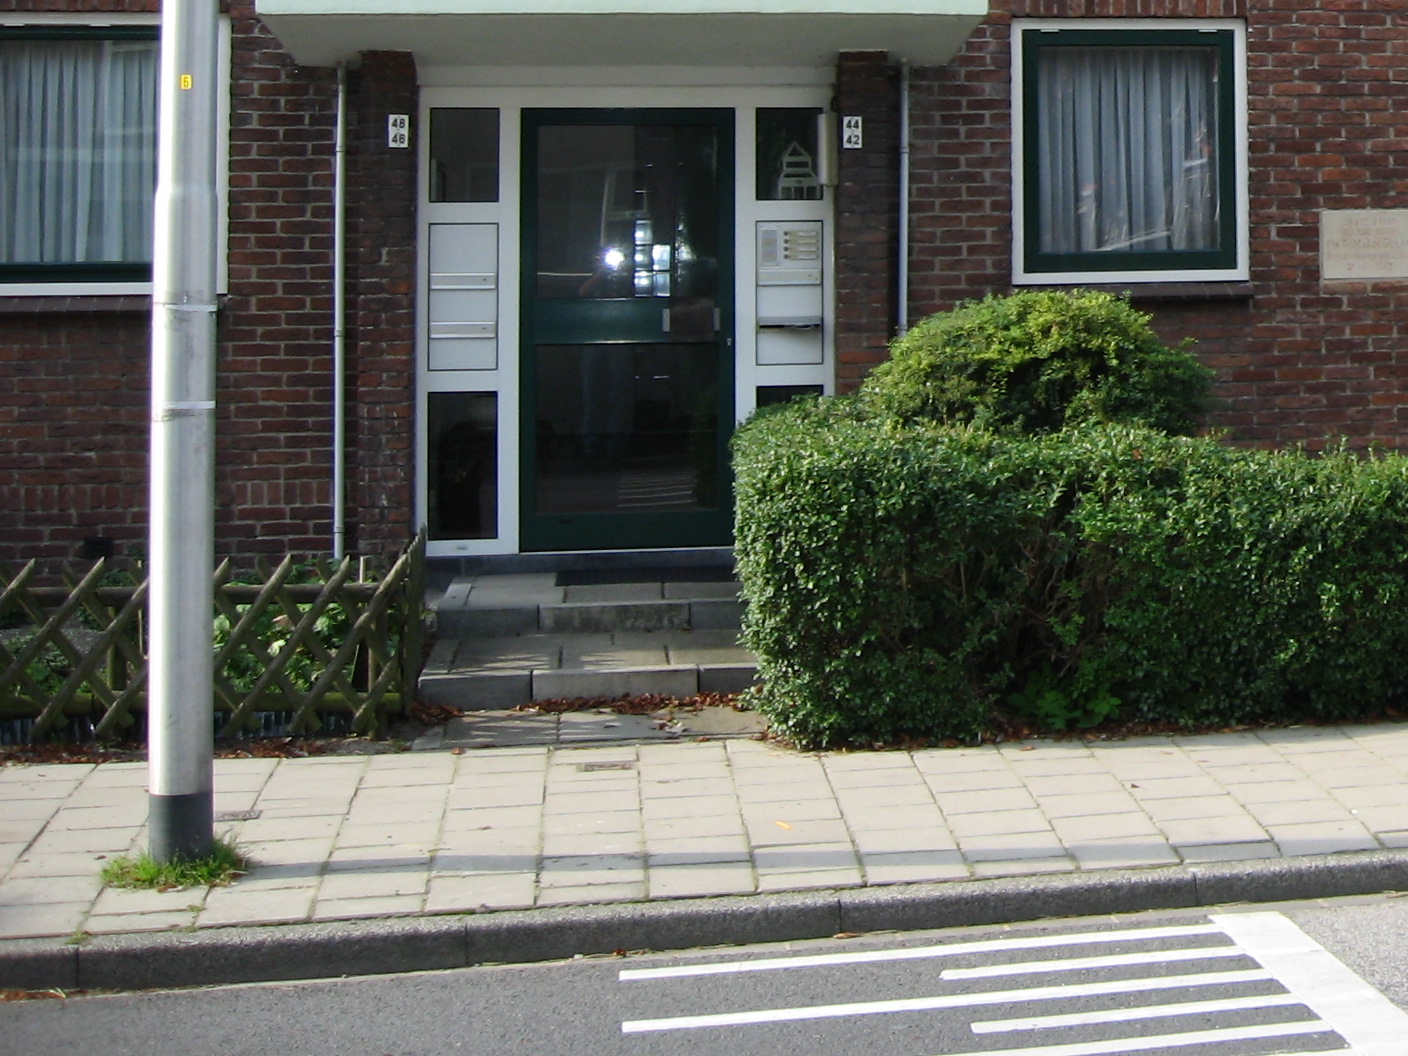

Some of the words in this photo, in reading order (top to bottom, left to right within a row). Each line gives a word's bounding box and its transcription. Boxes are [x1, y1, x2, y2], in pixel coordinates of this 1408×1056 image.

[391, 118, 406, 129] 48
[845, 119, 860, 129] 44
[391, 133, 406, 144] 46
[845, 134, 860, 145] 42
